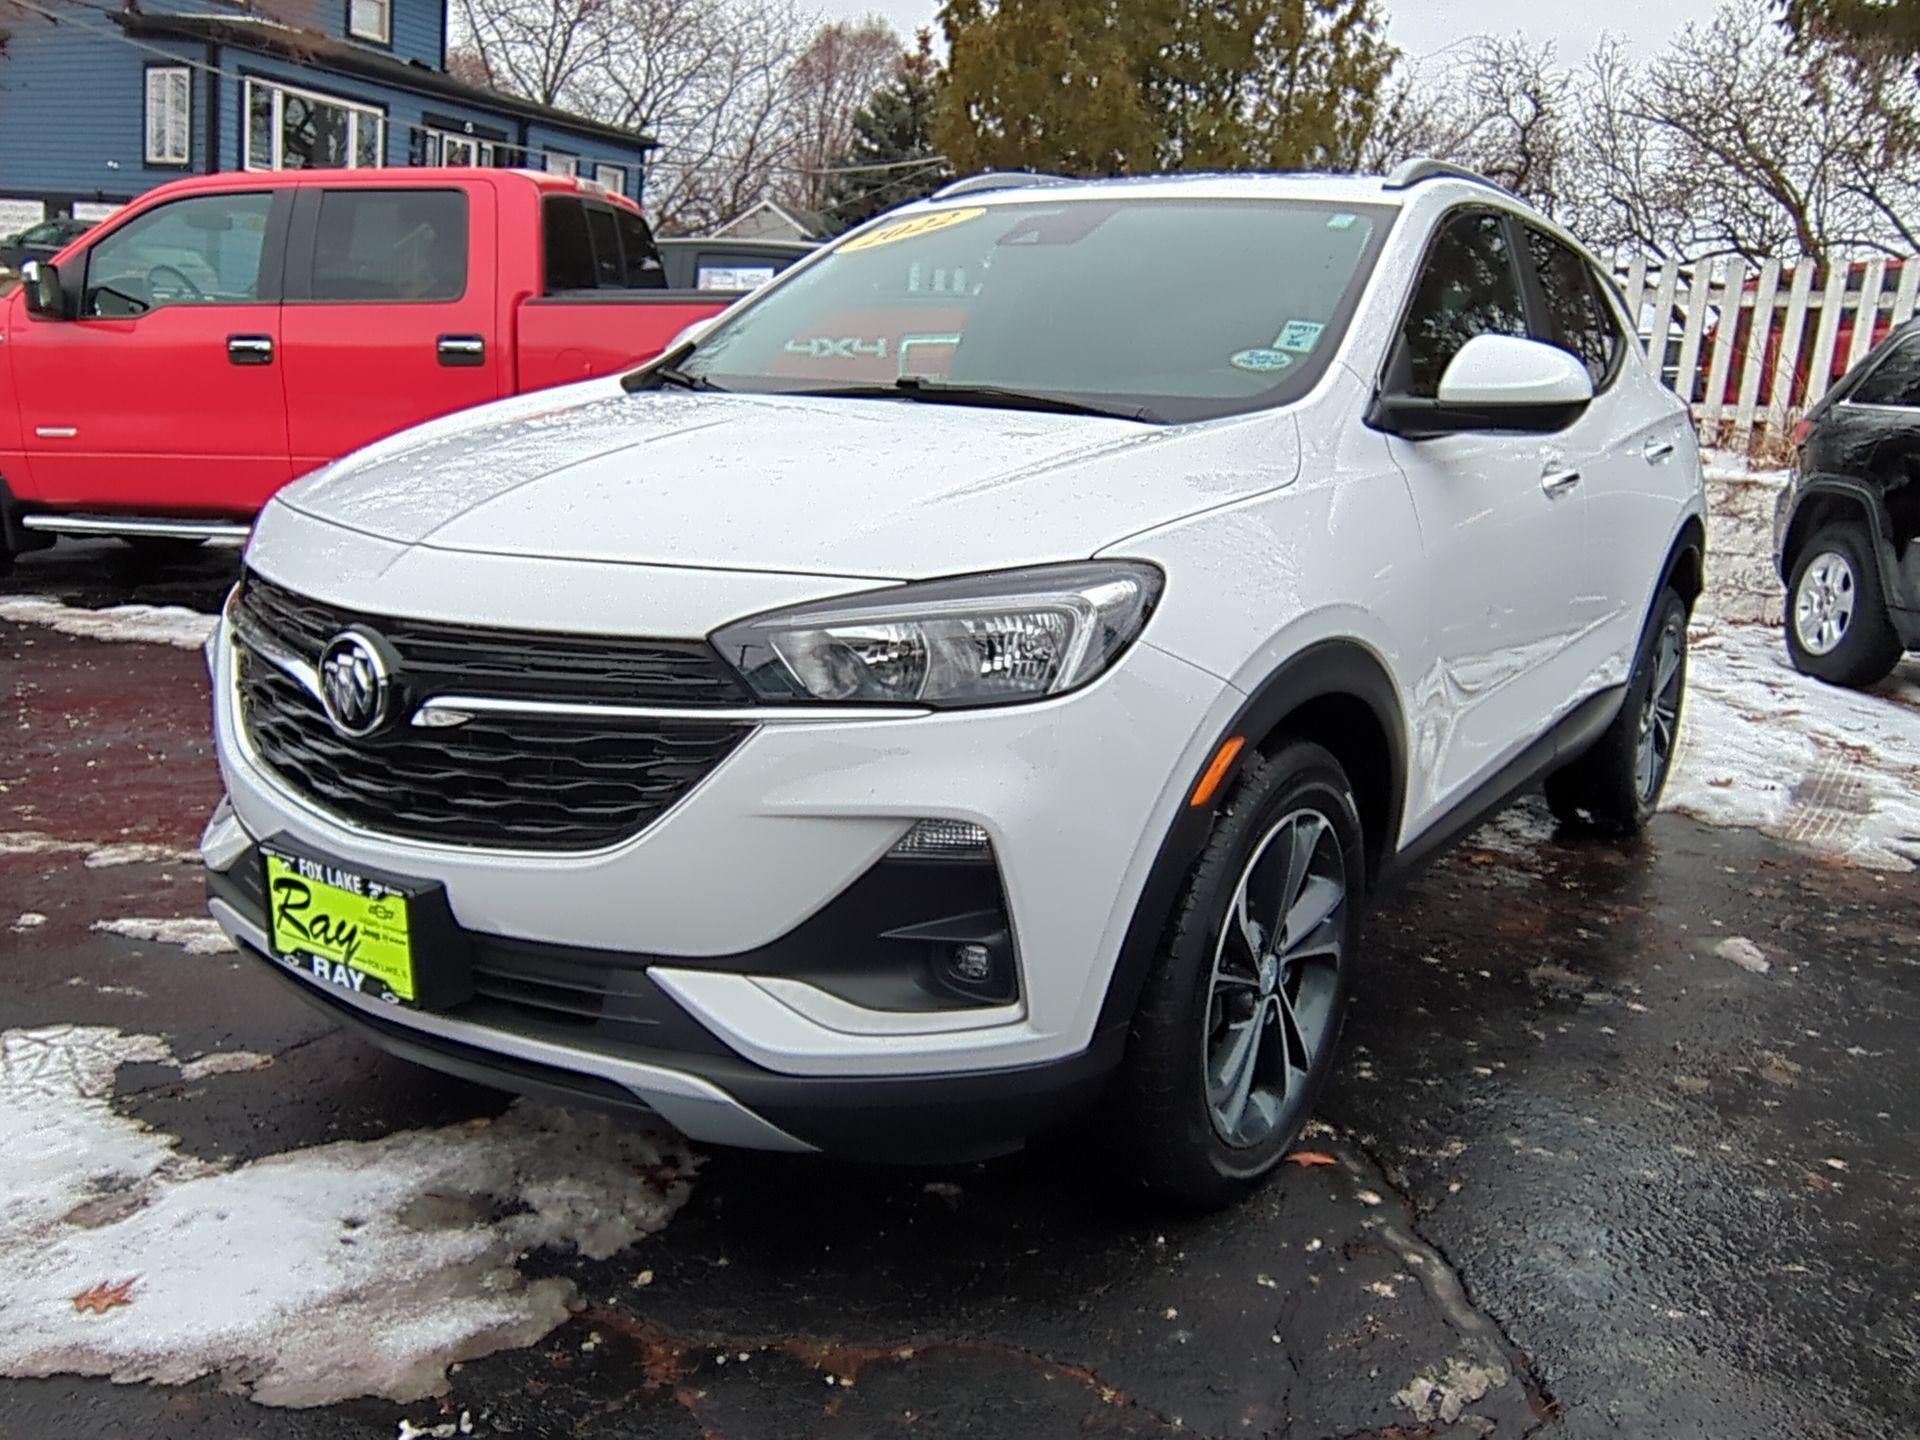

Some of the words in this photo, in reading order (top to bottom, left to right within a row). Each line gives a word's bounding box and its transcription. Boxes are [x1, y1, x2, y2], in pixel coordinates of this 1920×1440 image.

[299, 857, 323, 882] FOX
[326, 864, 363, 895] LAKE
[273, 877, 362, 967] Ray
[312, 954, 365, 993] RAY
